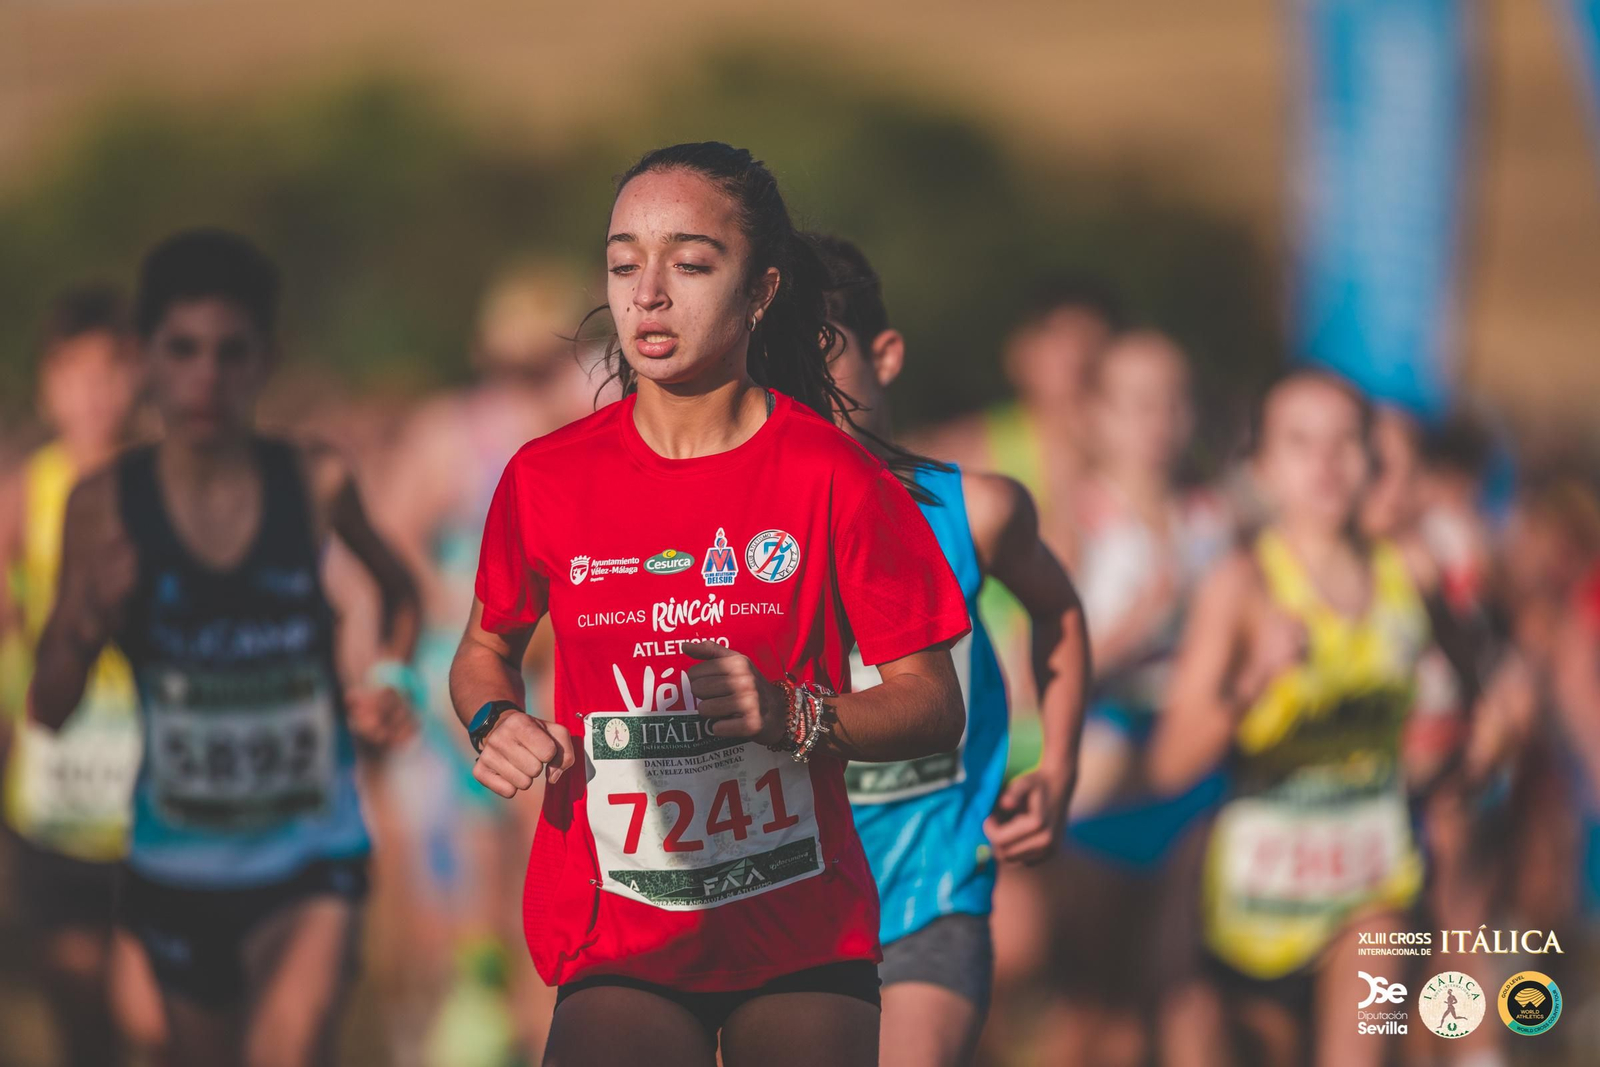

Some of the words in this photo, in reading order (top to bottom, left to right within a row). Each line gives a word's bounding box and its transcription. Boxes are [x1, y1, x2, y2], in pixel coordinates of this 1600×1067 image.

[591, 557, 640, 568] Ayuntamiento
[646, 558, 691, 570] Cesurca
[590, 566, 639, 576] Vélez-Málaga
[707, 576, 733, 585] DELSUR
[577, 609, 646, 628] CLINICAS
[730, 603, 784, 615] DENTAL
[644, 757, 683, 768] DANIELA
[684, 751, 721, 765] MILLAN
[722, 745, 745, 758] RIOS
[660, 768, 684, 776] VELEZ
[684, 763, 713, 774] RINCON
[714, 756, 745, 769] DENTAL
[607, 767, 799, 855] 7241
